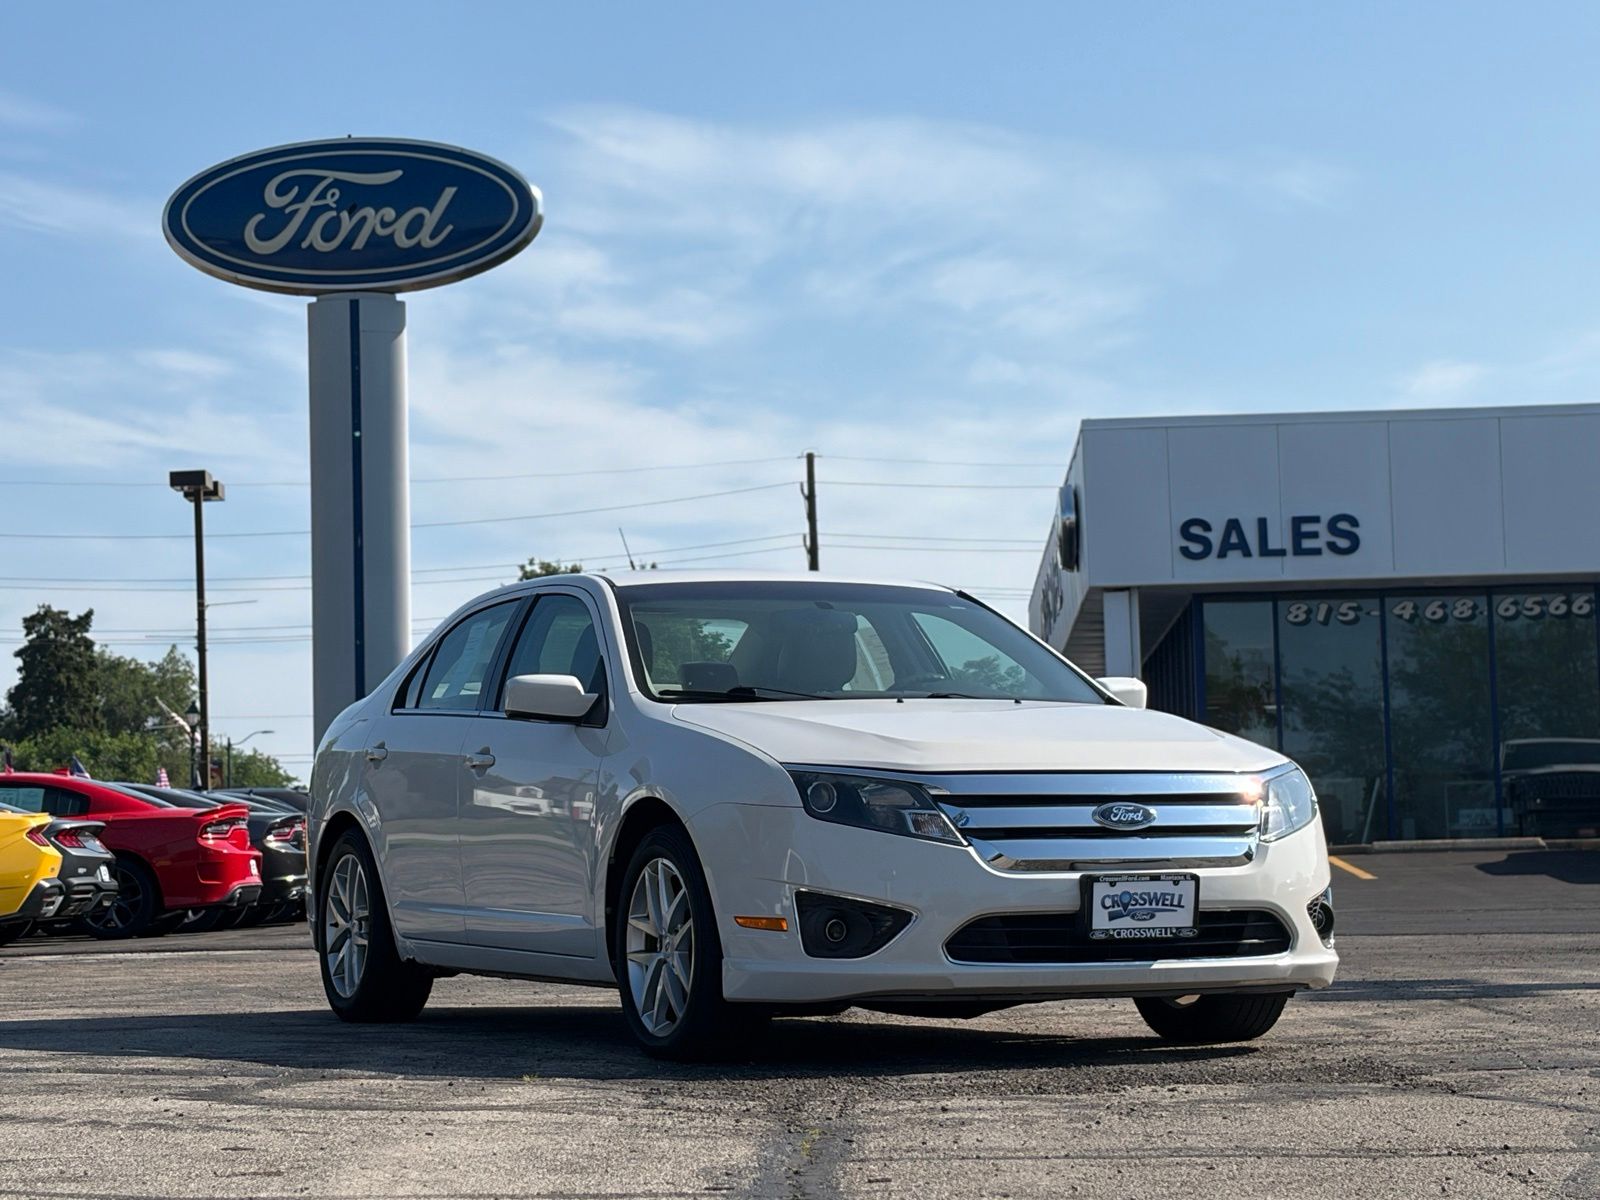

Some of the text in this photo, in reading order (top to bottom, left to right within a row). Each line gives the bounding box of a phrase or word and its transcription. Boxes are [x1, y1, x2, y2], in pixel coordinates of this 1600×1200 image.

[244, 168, 458, 255] Ford
[1178, 513, 1361, 561] SALES
[1110, 806, 1144, 821] Ford
[1100, 890, 1185, 909] CROSSWELL
[1134, 911, 1152, 920] Ford
[1113, 928, 1173, 939] CROSSWELL
